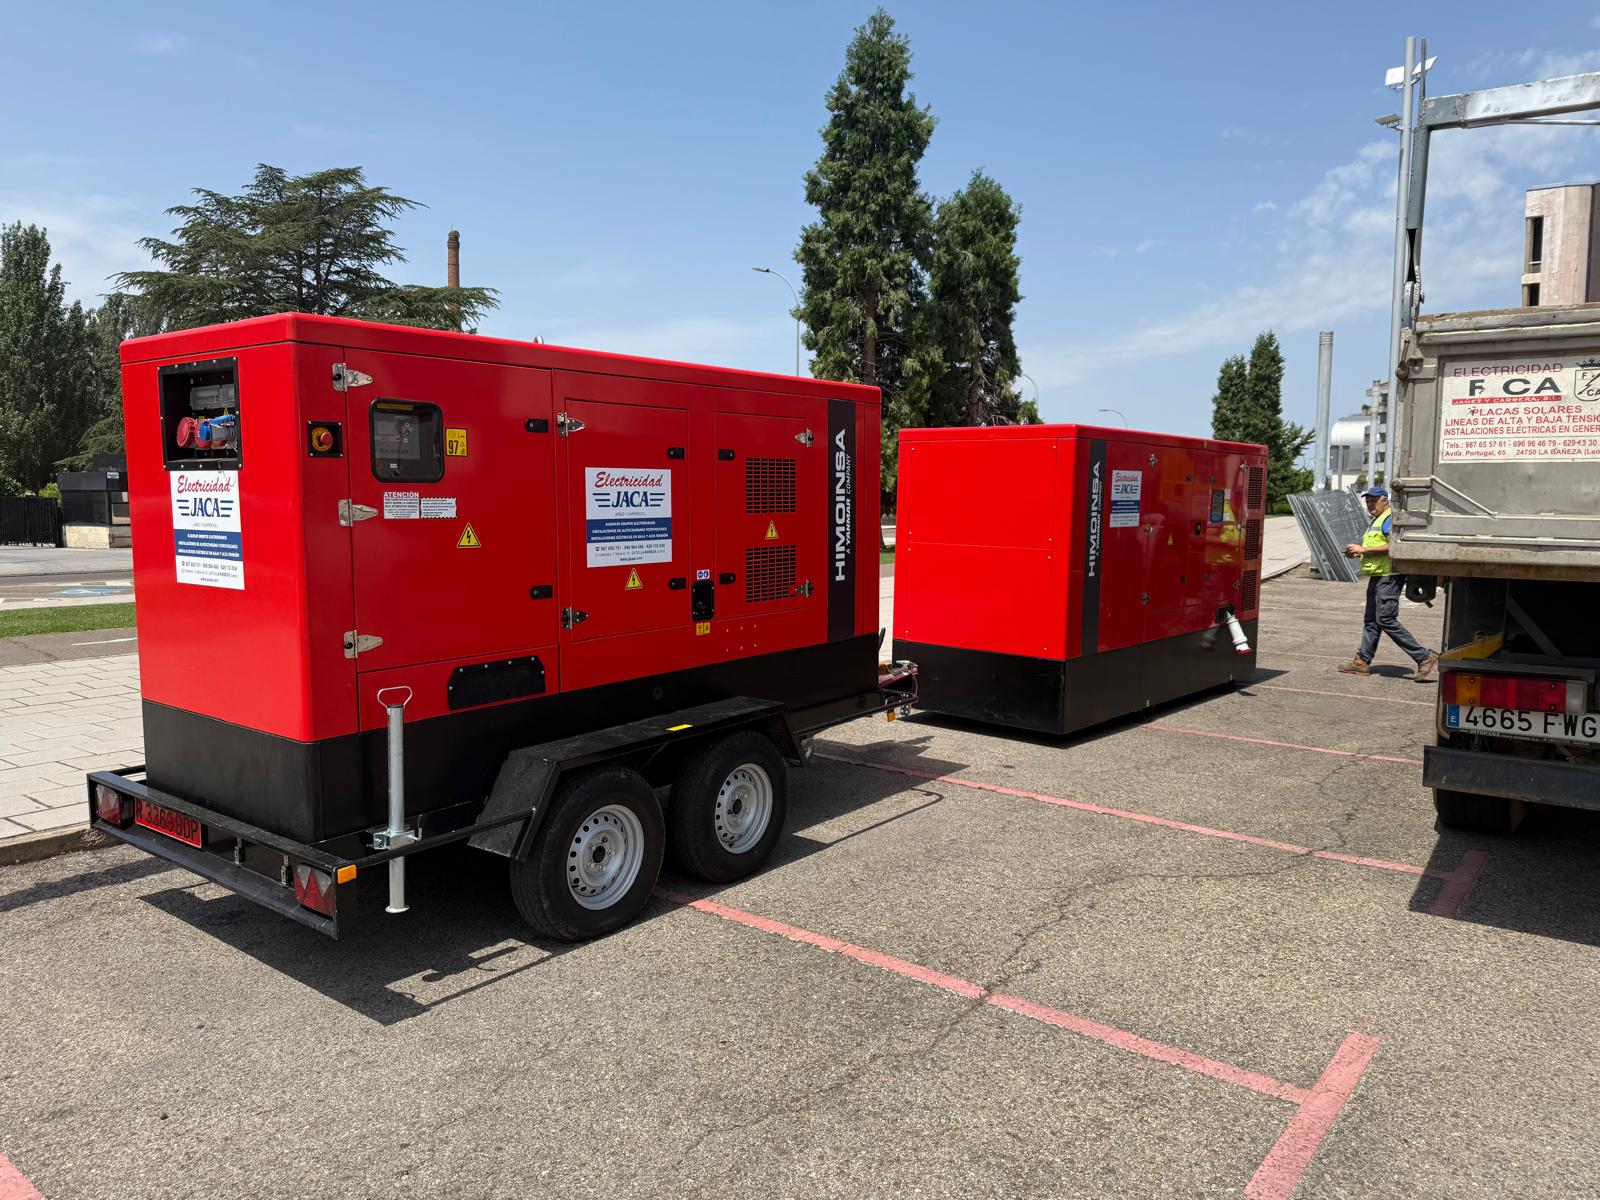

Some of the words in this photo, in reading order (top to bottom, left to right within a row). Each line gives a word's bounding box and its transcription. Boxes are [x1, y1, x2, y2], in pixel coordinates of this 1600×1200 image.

[1453, 363, 1564, 377] ELECTRICIDAD
[1469, 379, 1486, 397] F
[1502, 377, 1562, 396] CA
[1471, 407, 1520, 416] PLACAS
[1523, 405, 1583, 415] SOLARES
[1445, 417, 1479, 427] LINEAS
[1481, 417, 1495, 426] DE
[1497, 416, 1523, 425] ALTA
[1527, 416, 1534, 424] Y
[1535, 415, 1563, 424] BAJA
[1443, 426, 1504, 436] INSTALACIONES
[1559, 425, 1570, 433] EN
[448, 440, 459, 455] 97
[1465, 441, 1477, 449] 987
[1488, 440, 1497, 448] 57
[1498, 440, 1506, 448] 61
[1513, 440, 1526, 448] 696
[1527, 440, 1536, 448] 96
[1537, 439, 1546, 447] 46
[1547, 439, 1557, 447] 79
[1563, 439, 1576, 447] 629
[1588, 438, 1597, 447] 30
[177, 474, 231, 494] Electricidad
[594, 471, 663, 489] Electricidad
[190, 497, 220, 518] JACA
[611, 490, 650, 508] JACA
[835, 428, 846, 582] HIMOINSA
[1088, 460, 1100, 577] HIMOINSA
[1465, 706, 1533, 732] 4665
[1543, 713, 1598, 738] FWG
[136, 798, 143, 819] R
